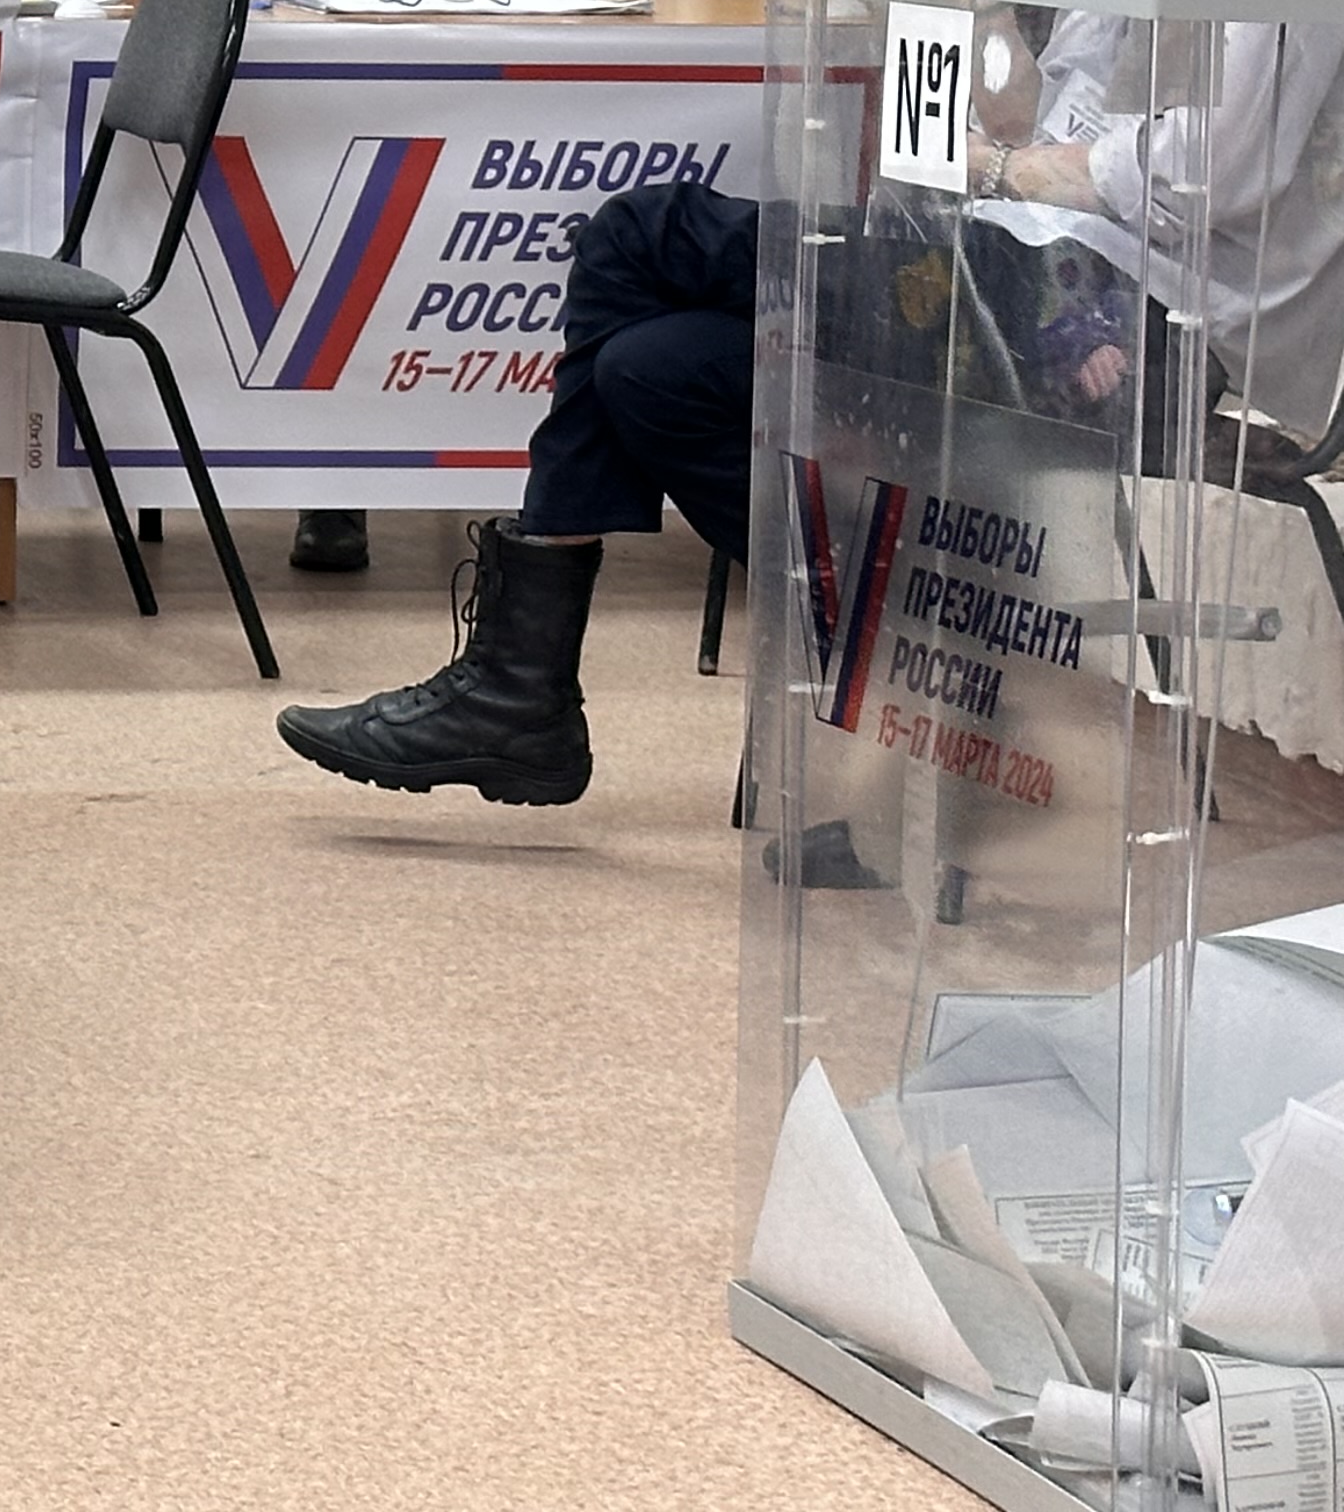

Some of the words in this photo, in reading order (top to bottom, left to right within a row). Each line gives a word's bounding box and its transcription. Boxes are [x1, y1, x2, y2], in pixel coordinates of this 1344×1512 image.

[895, 37, 961, 163] №1
[470, 139, 732, 191] ВЫБОРЫ
[406, 282, 569, 334] РОСС
[381, 349, 499, 394] 15–17
[918, 494, 1047, 579] ВЫБОРЫ
[903, 565, 1085, 671] ПРЕЗИДЕНТА
[888, 634, 1004, 720] РОССИИ
[930, 721, 1001, 788] МАРТА
[1003, 748, 1055, 808] 2024
